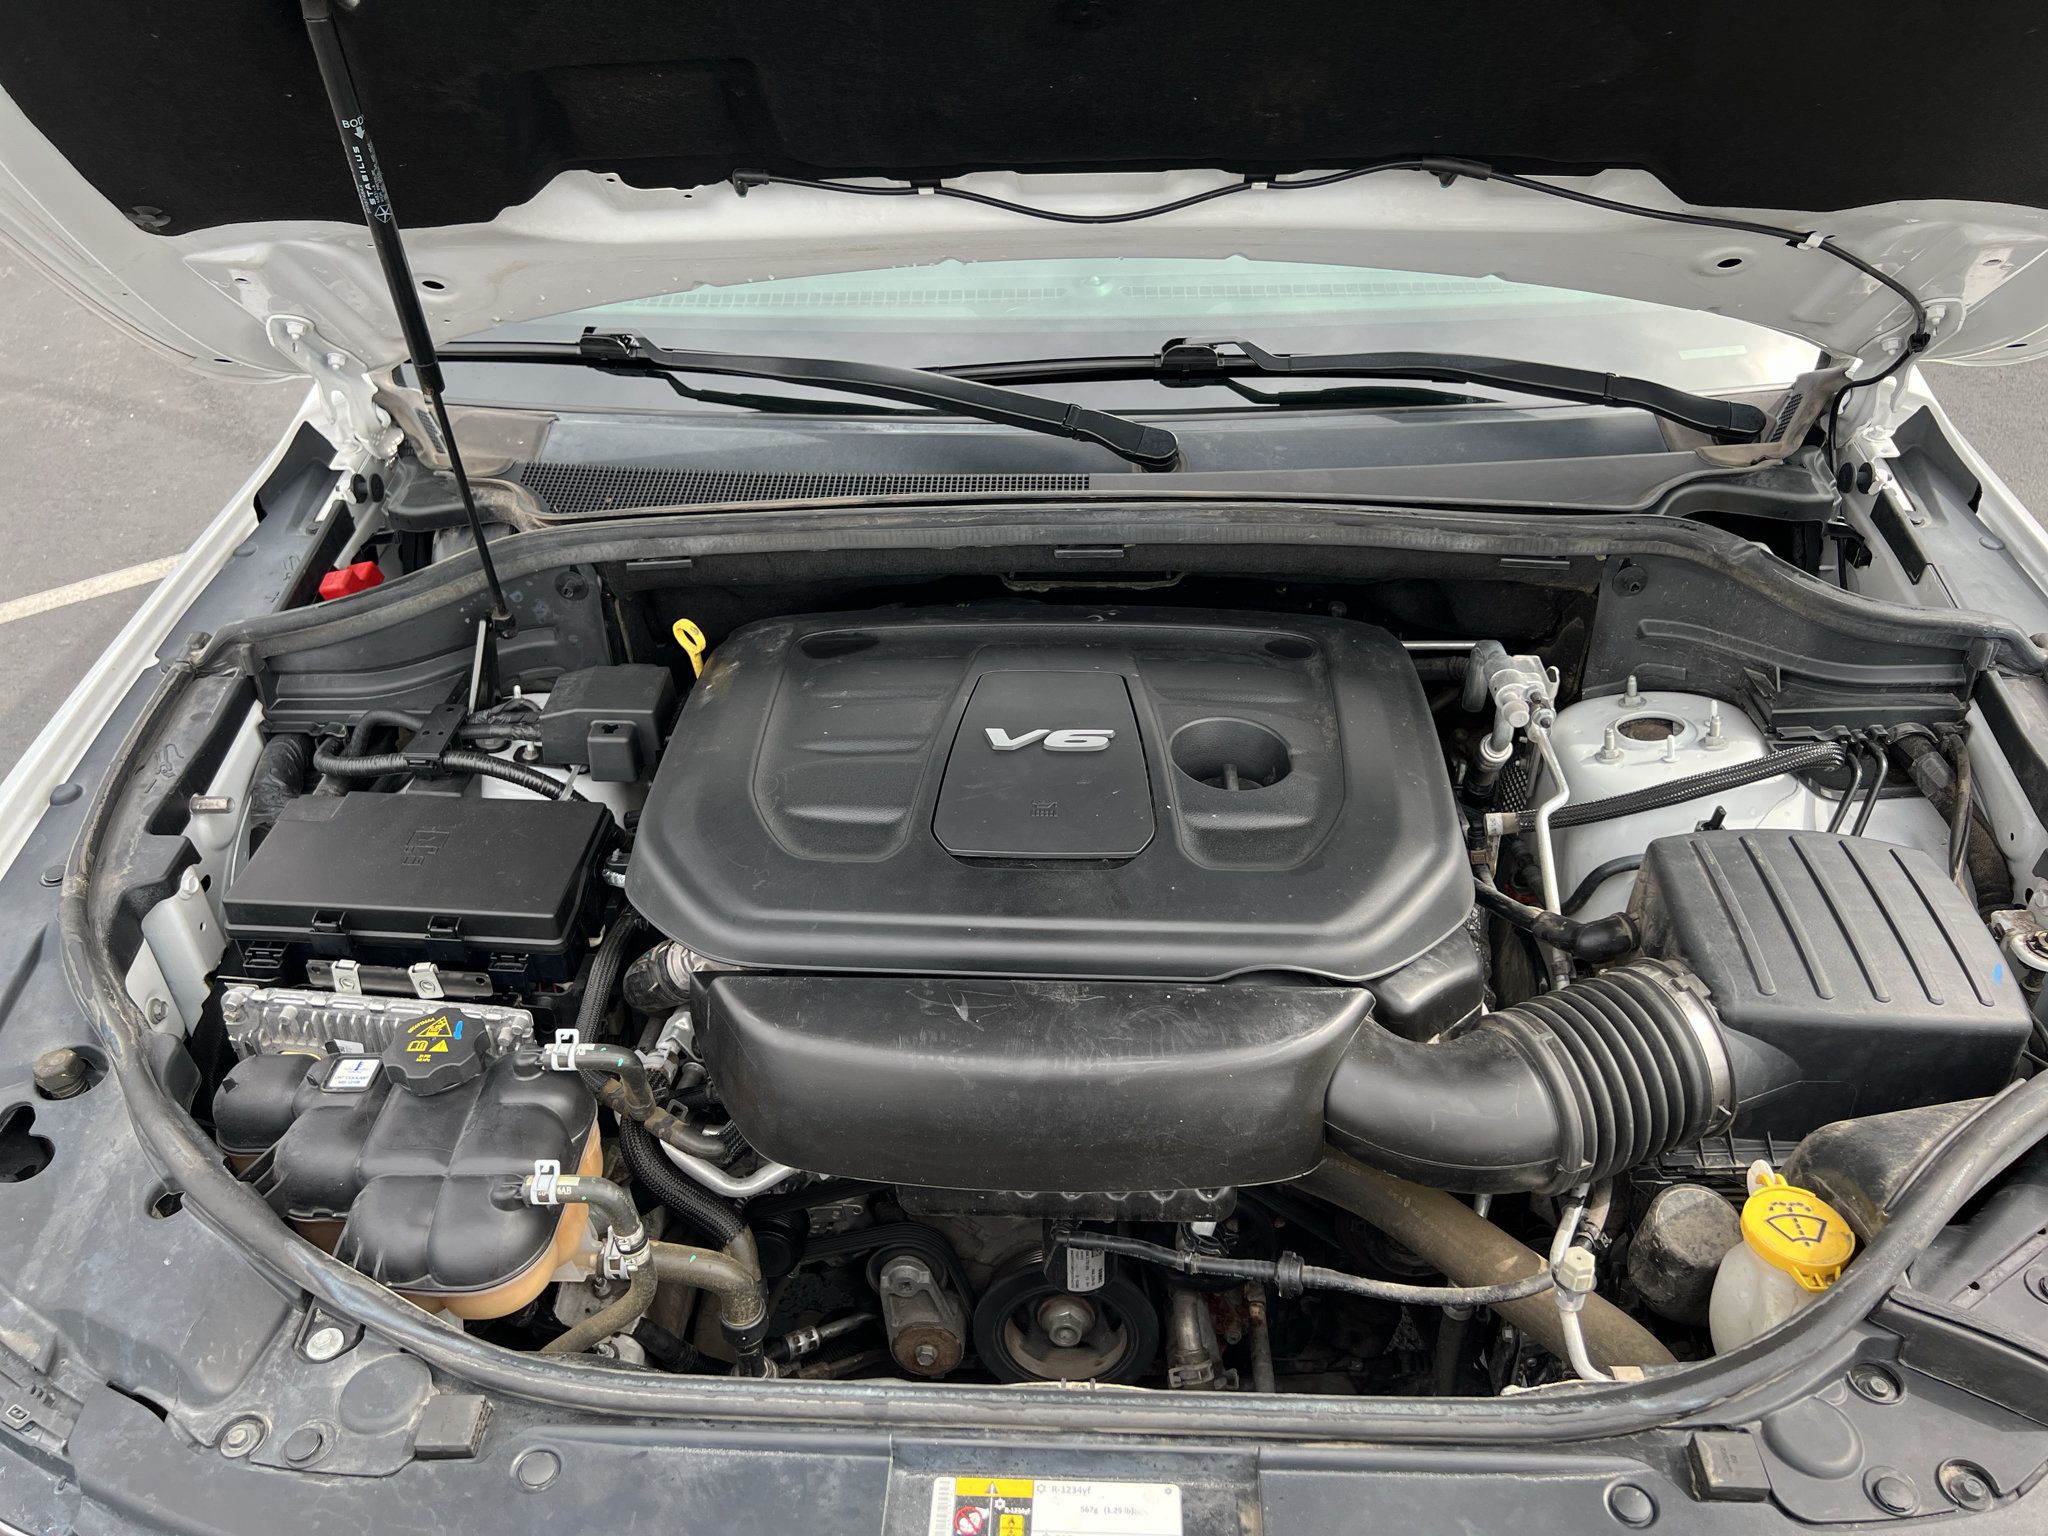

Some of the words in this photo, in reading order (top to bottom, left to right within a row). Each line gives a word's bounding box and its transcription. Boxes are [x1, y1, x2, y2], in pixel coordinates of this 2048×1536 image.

[352, 145, 377, 206] STABILUS
[984, 727, 1116, 752] V6
[1051, 1485, 1092, 1495] R-1234yf
[1080, 1505, 1099, 1515] 567g
